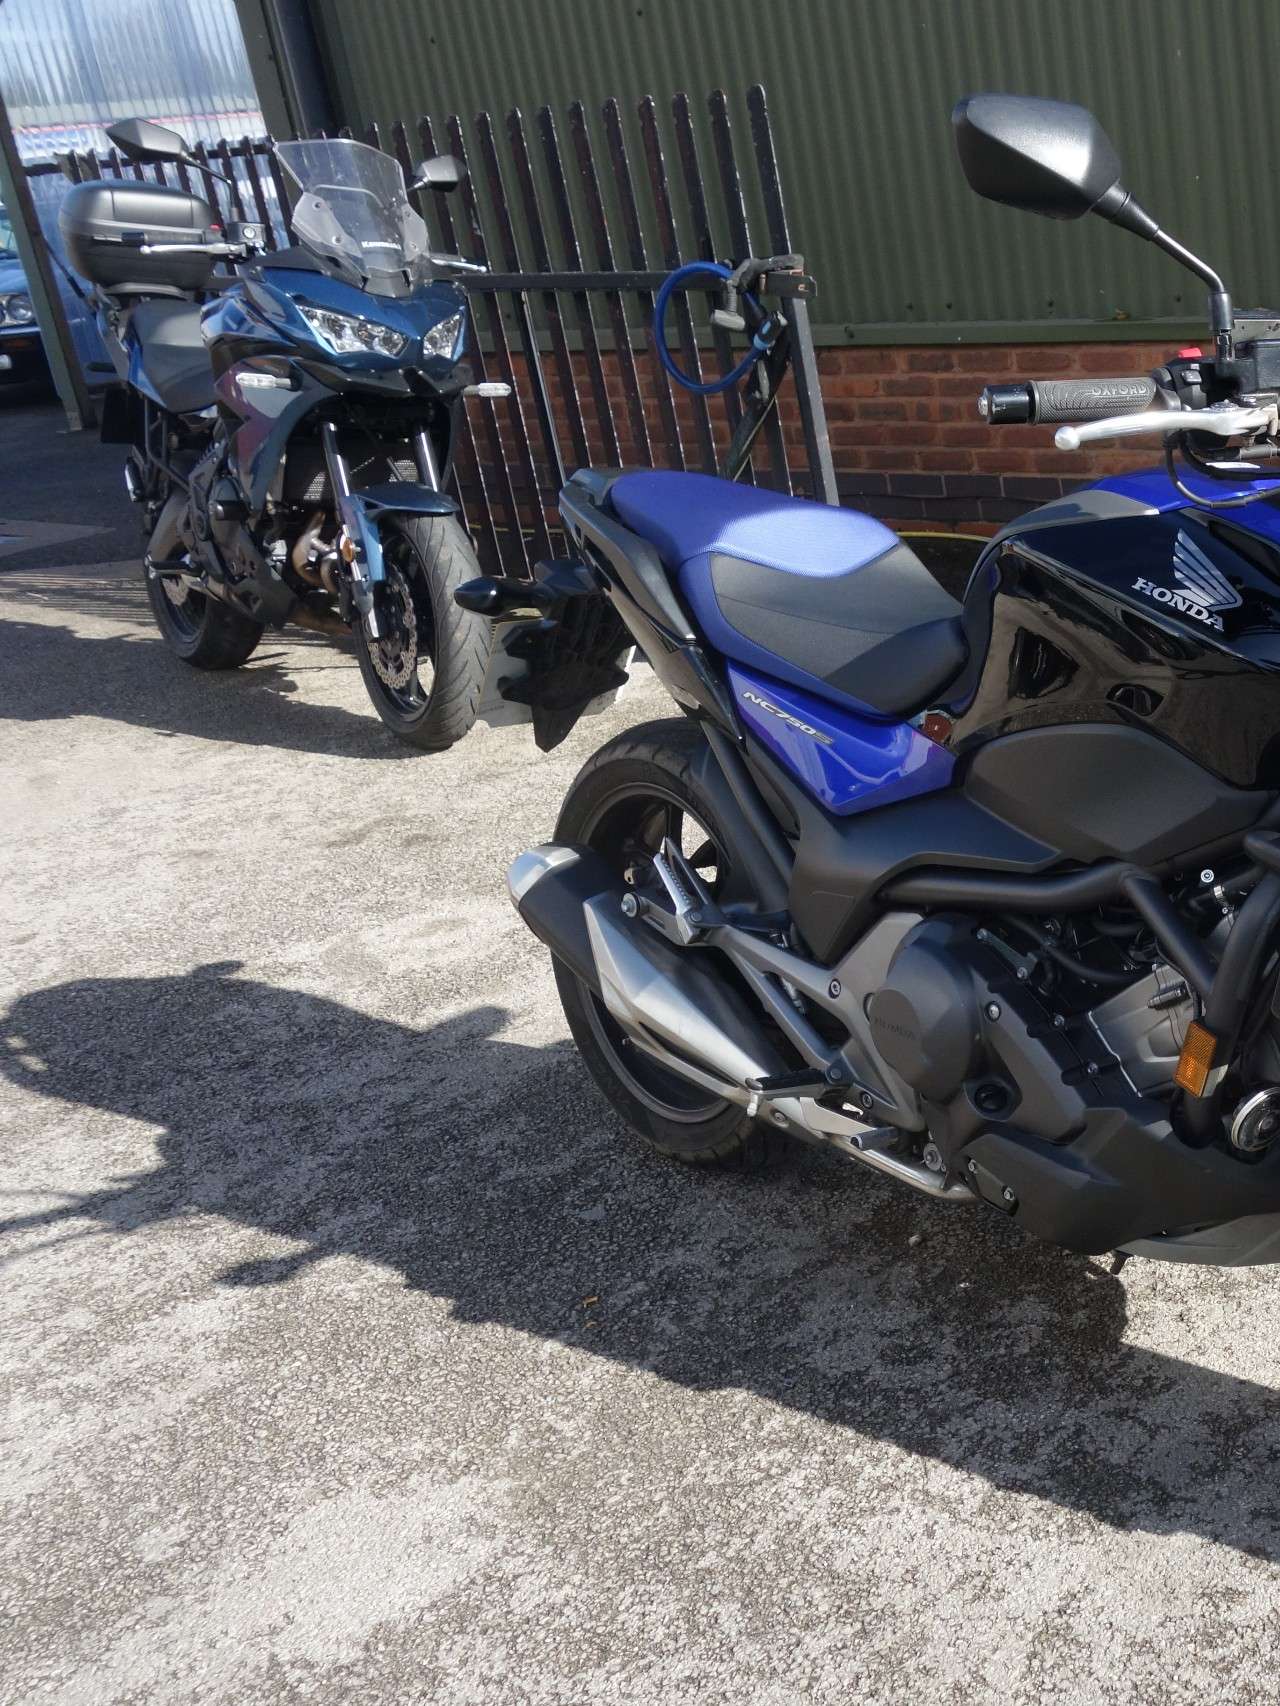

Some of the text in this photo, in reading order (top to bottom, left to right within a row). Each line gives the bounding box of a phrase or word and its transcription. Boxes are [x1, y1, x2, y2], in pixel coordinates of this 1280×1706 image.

[1091, 383, 1149, 396] OXFORD
[1131, 577, 1225, 632] HONDA
[743, 691, 833, 745] NC750S
